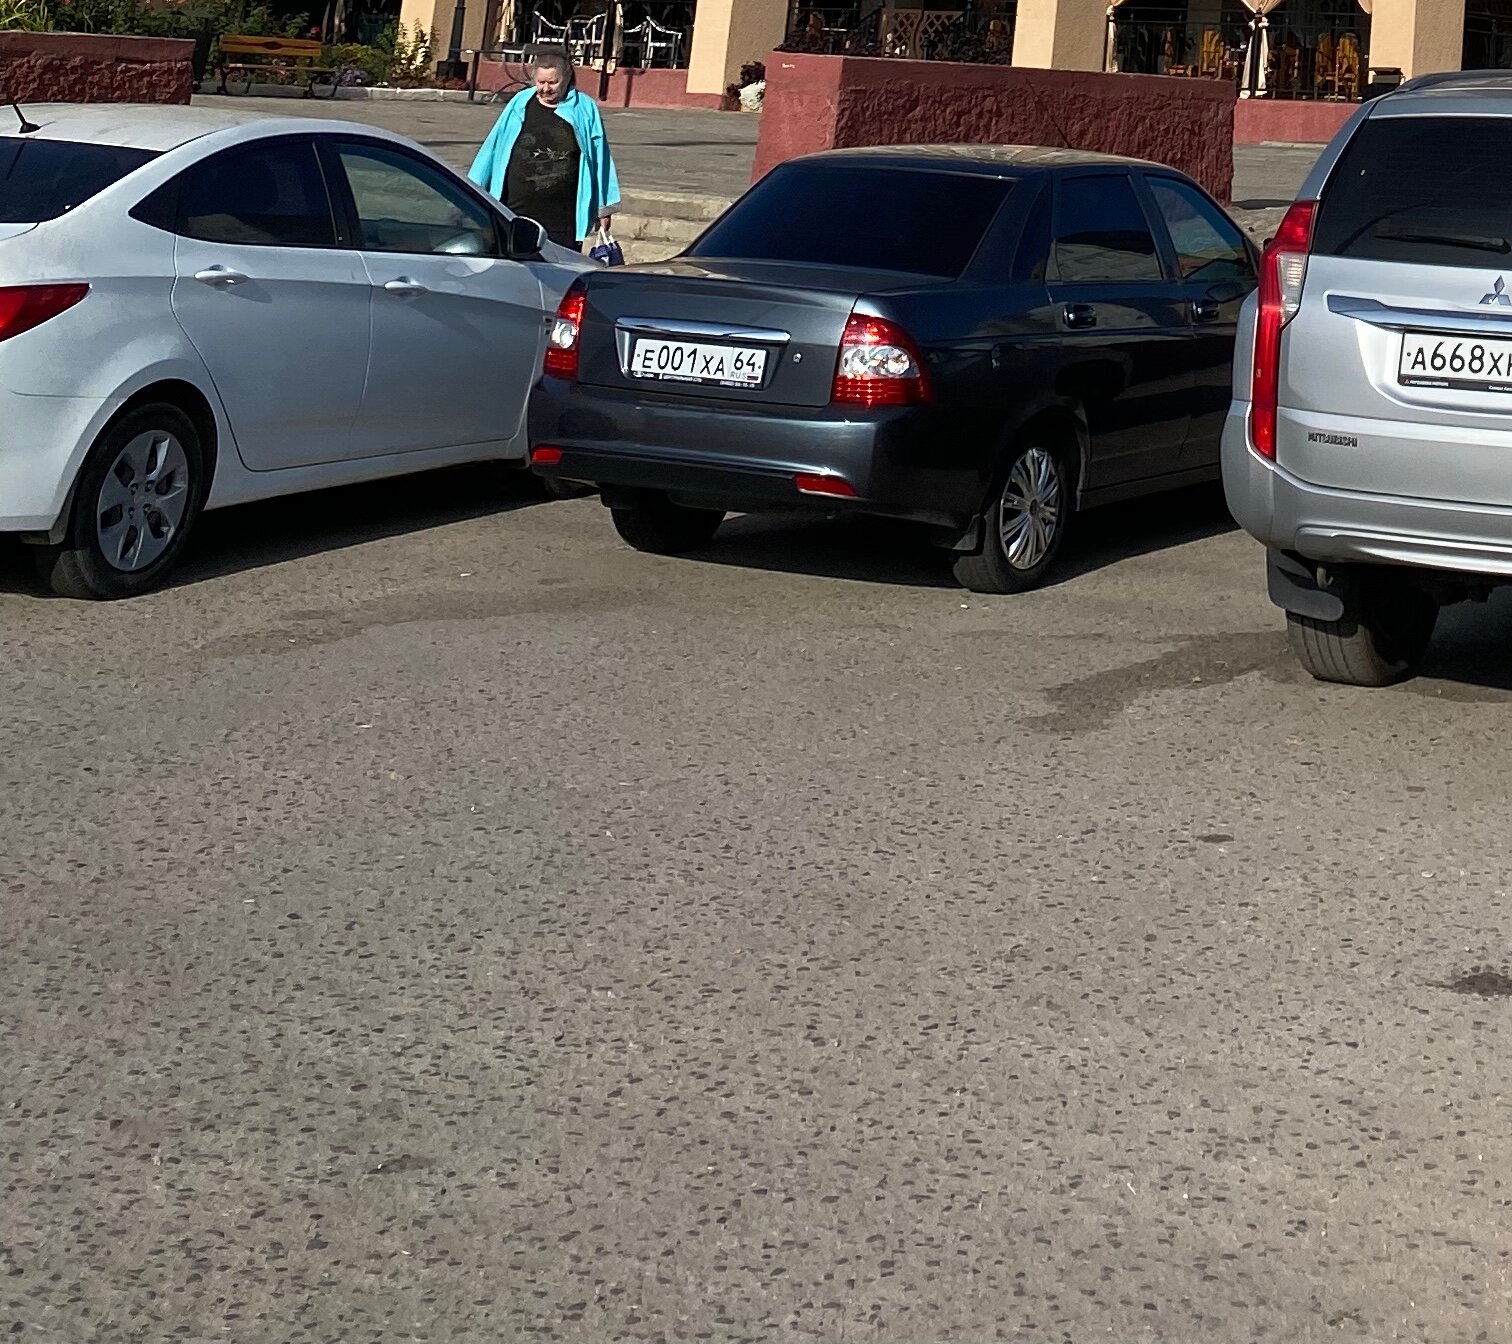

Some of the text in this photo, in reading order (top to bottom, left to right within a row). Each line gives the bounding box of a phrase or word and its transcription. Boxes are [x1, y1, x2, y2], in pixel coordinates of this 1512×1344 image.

[642, 345, 756, 377] Е001ХА 64
[729, 371, 747, 380] RUS
